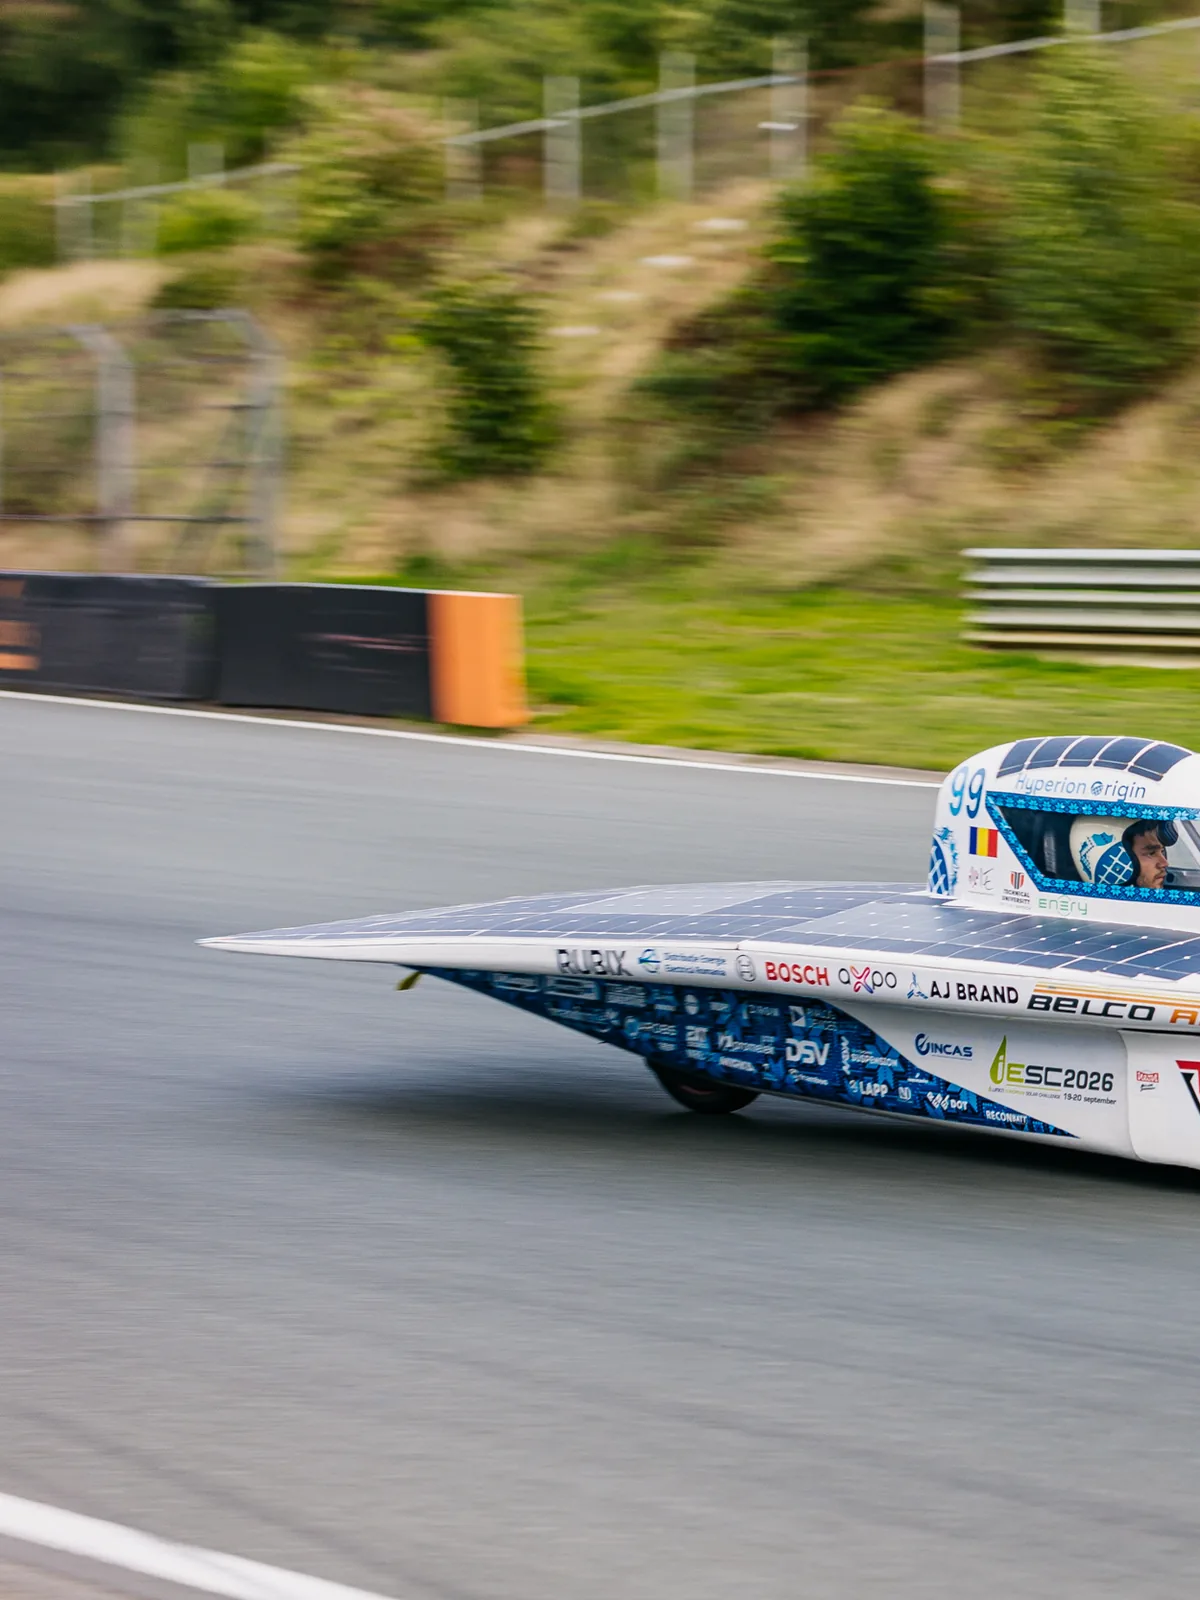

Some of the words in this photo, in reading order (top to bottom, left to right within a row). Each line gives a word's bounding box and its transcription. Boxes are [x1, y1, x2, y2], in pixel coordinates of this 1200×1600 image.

[948, 766, 986, 819] 99
[1015, 773, 1087, 796] Hyperion
[765, 961, 830, 987] BOSCH
[838, 965, 898, 994] axpo
[930, 981, 951, 999] AJ
[957, 983, 1019, 1004] BRAND
[785, 1037, 831, 1066] DSV
[930, 1043, 973, 1058] INCAS
[859, 1081, 889, 1098] LAPP
[1083, 1096, 1117, 1105] september
